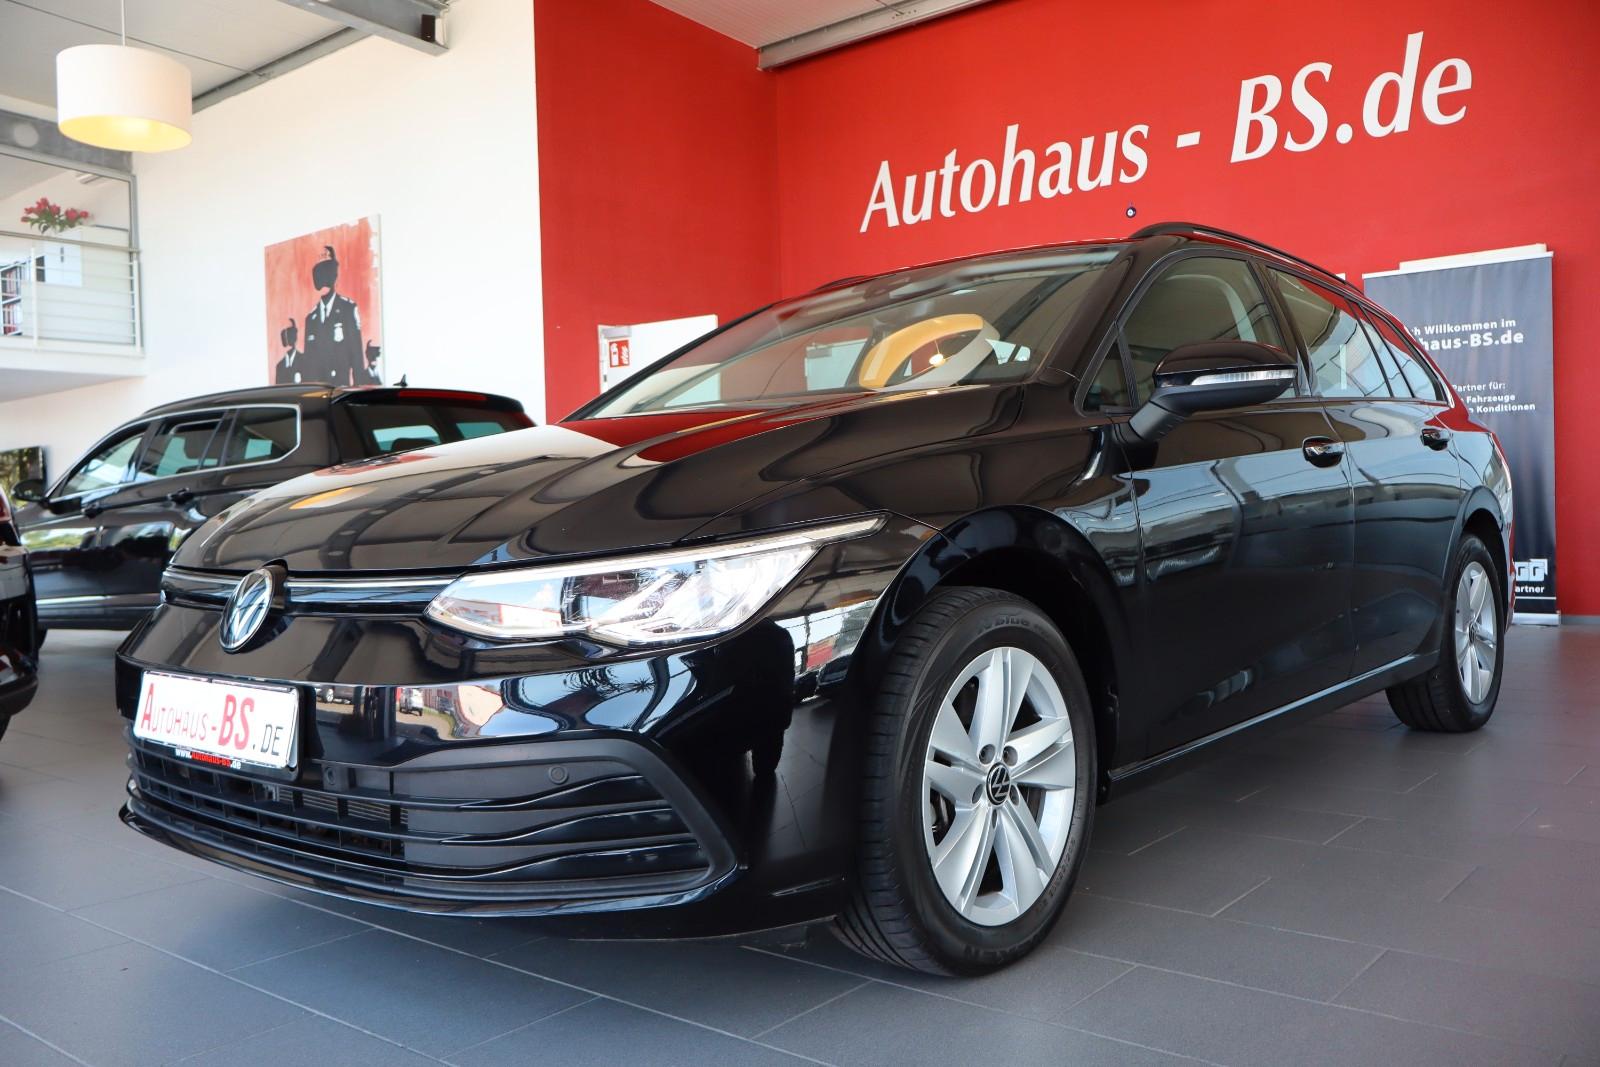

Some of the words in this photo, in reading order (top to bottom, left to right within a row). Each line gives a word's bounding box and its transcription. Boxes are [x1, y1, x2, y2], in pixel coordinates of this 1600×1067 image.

[859, 124, 1149, 233] Autohaus
[1176, 131, 1200, 148] -
[1230, 31, 1473, 163] BS.de
[1424, 321, 1498, 335] Willkommen
[1501, 318, 1516, 328] im
[1419, 330, 1524, 351] haus-BS.de
[1466, 394, 1516, 404] Fahrzeuge
[1476, 404, 1536, 414] Konditionen
[1515, 585, 1545, 593] artner
